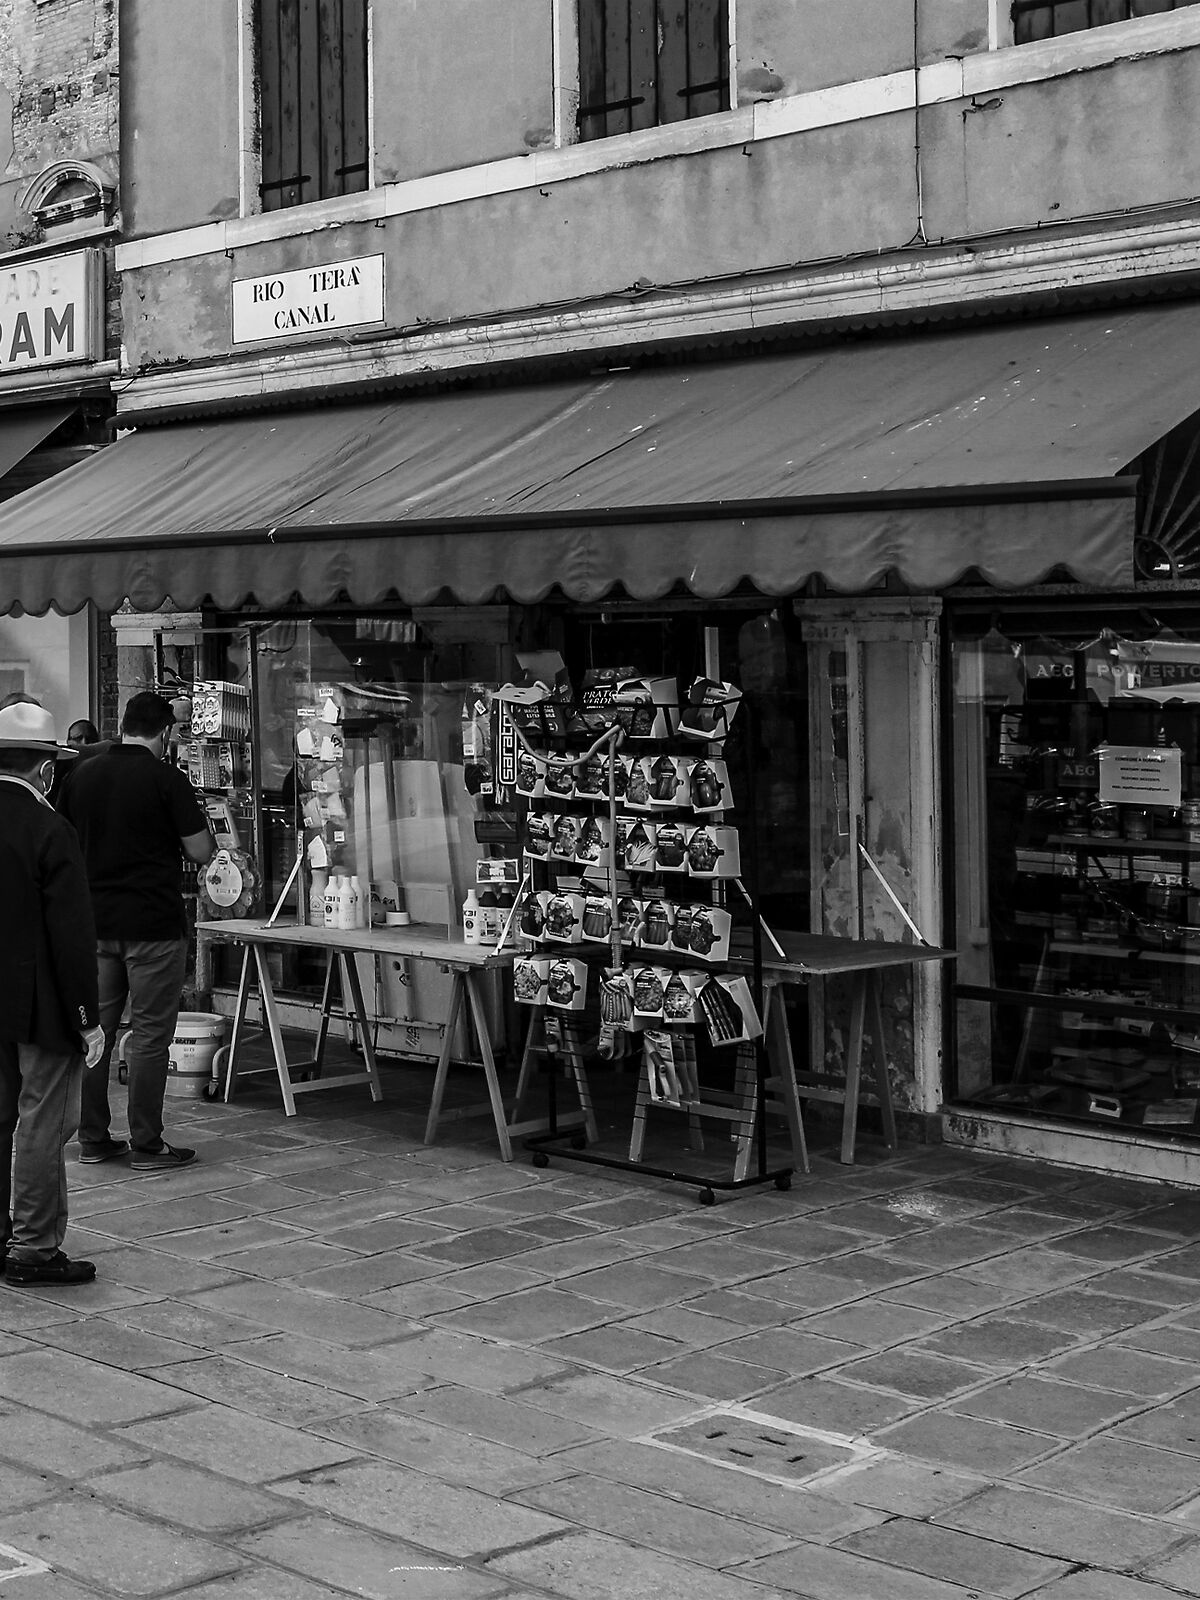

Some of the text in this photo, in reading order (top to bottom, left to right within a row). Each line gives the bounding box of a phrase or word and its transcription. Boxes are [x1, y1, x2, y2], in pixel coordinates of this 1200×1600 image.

[253, 281, 284, 303] RIO
[274, 303, 336, 329] CANAL
[1036, 664, 1074, 677] AEG
[1062, 764, 1096, 776] AEG
